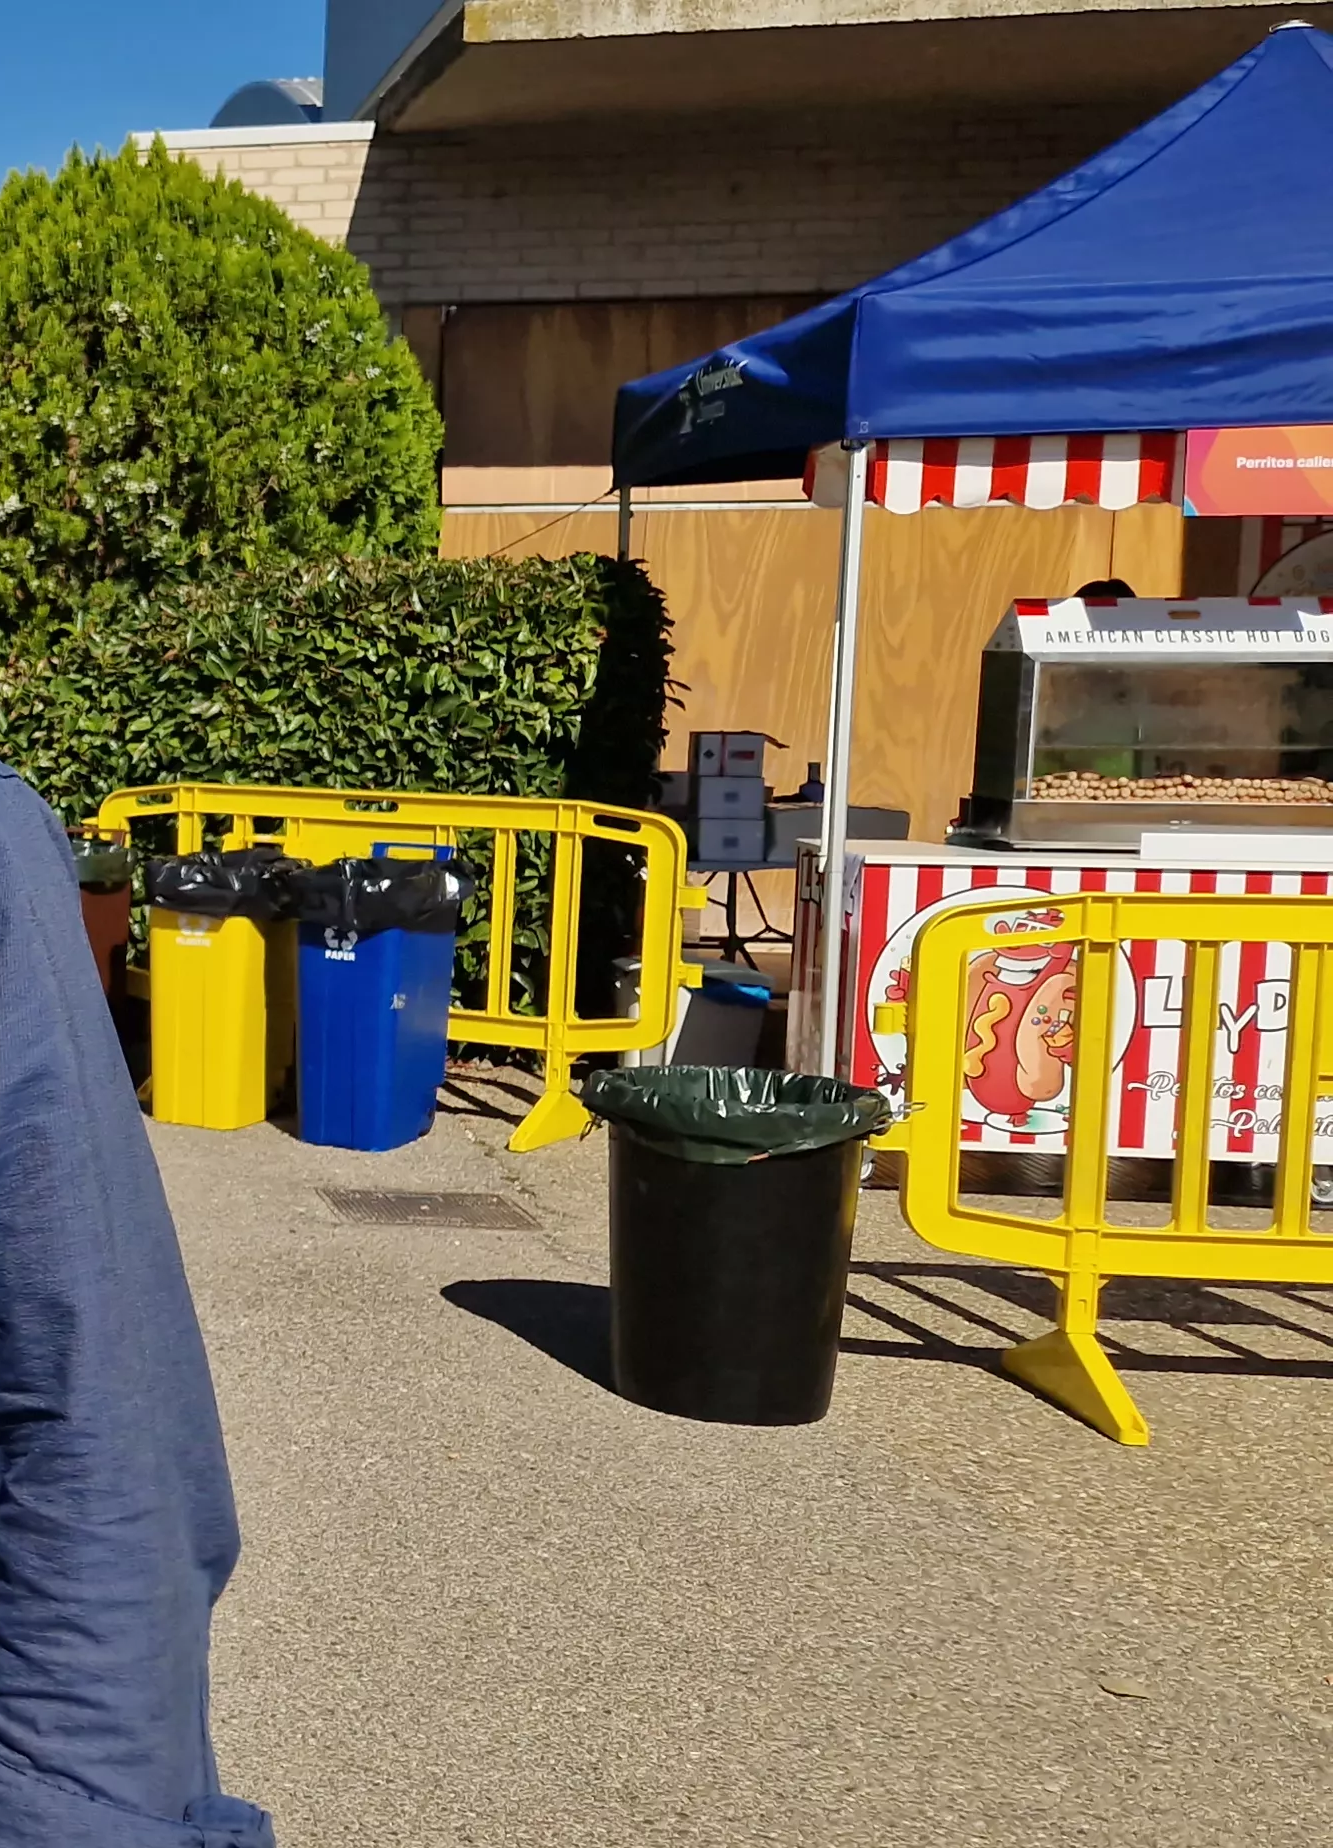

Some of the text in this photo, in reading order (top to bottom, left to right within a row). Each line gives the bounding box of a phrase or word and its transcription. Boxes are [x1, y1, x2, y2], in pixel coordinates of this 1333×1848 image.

[1236, 456, 1294, 469] Perritos
[1045, 630, 1331, 643] AMERICAN CLASSIC HOT DOG
[325, 949, 355, 962] PAPER
